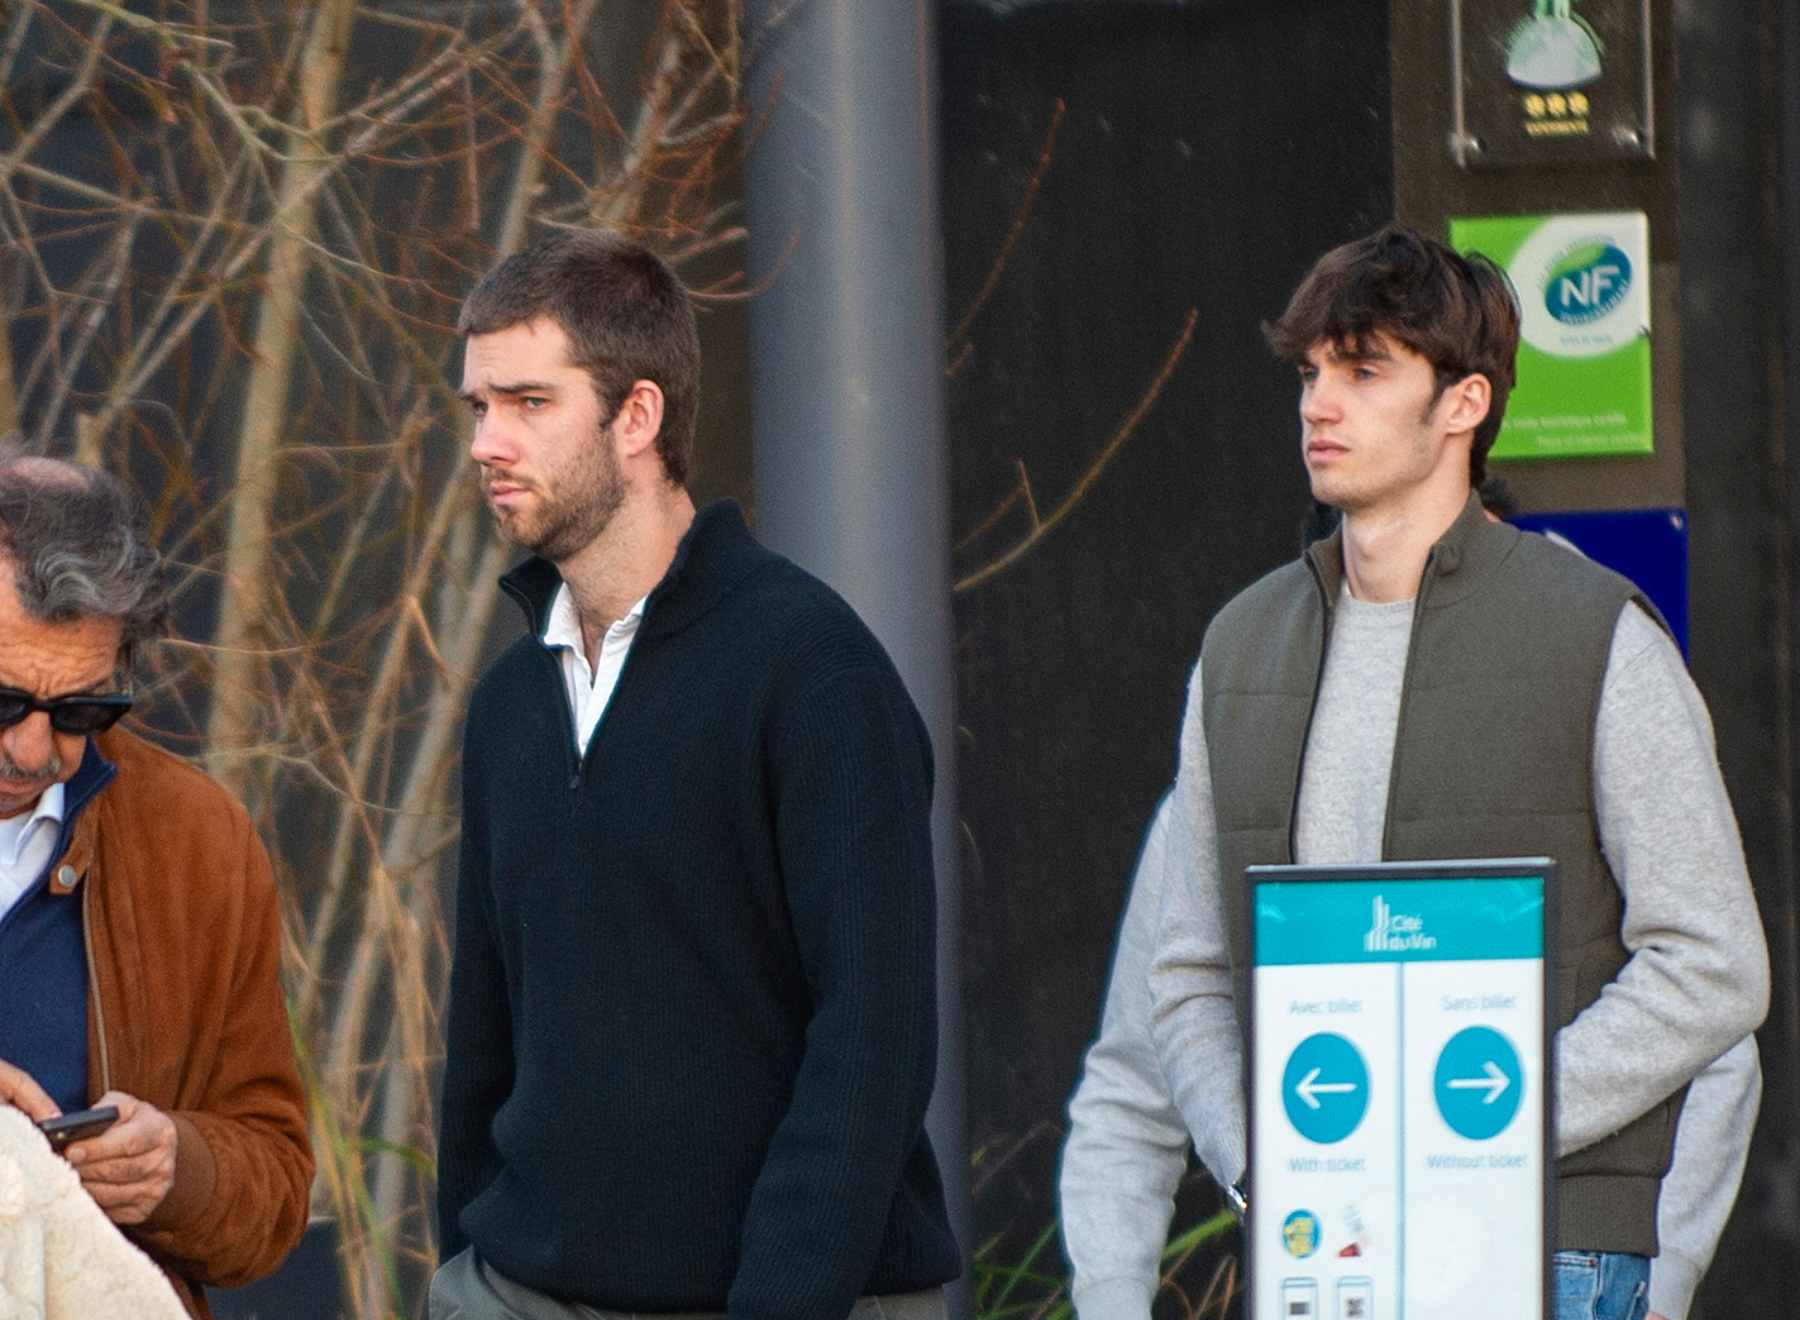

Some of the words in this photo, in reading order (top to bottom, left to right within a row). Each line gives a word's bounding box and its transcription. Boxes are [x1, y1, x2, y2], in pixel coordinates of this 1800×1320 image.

[1560, 264, 1620, 307] NF
[1391, 914, 1424, 932] Cité
[1288, 1156, 1318, 1172] With
